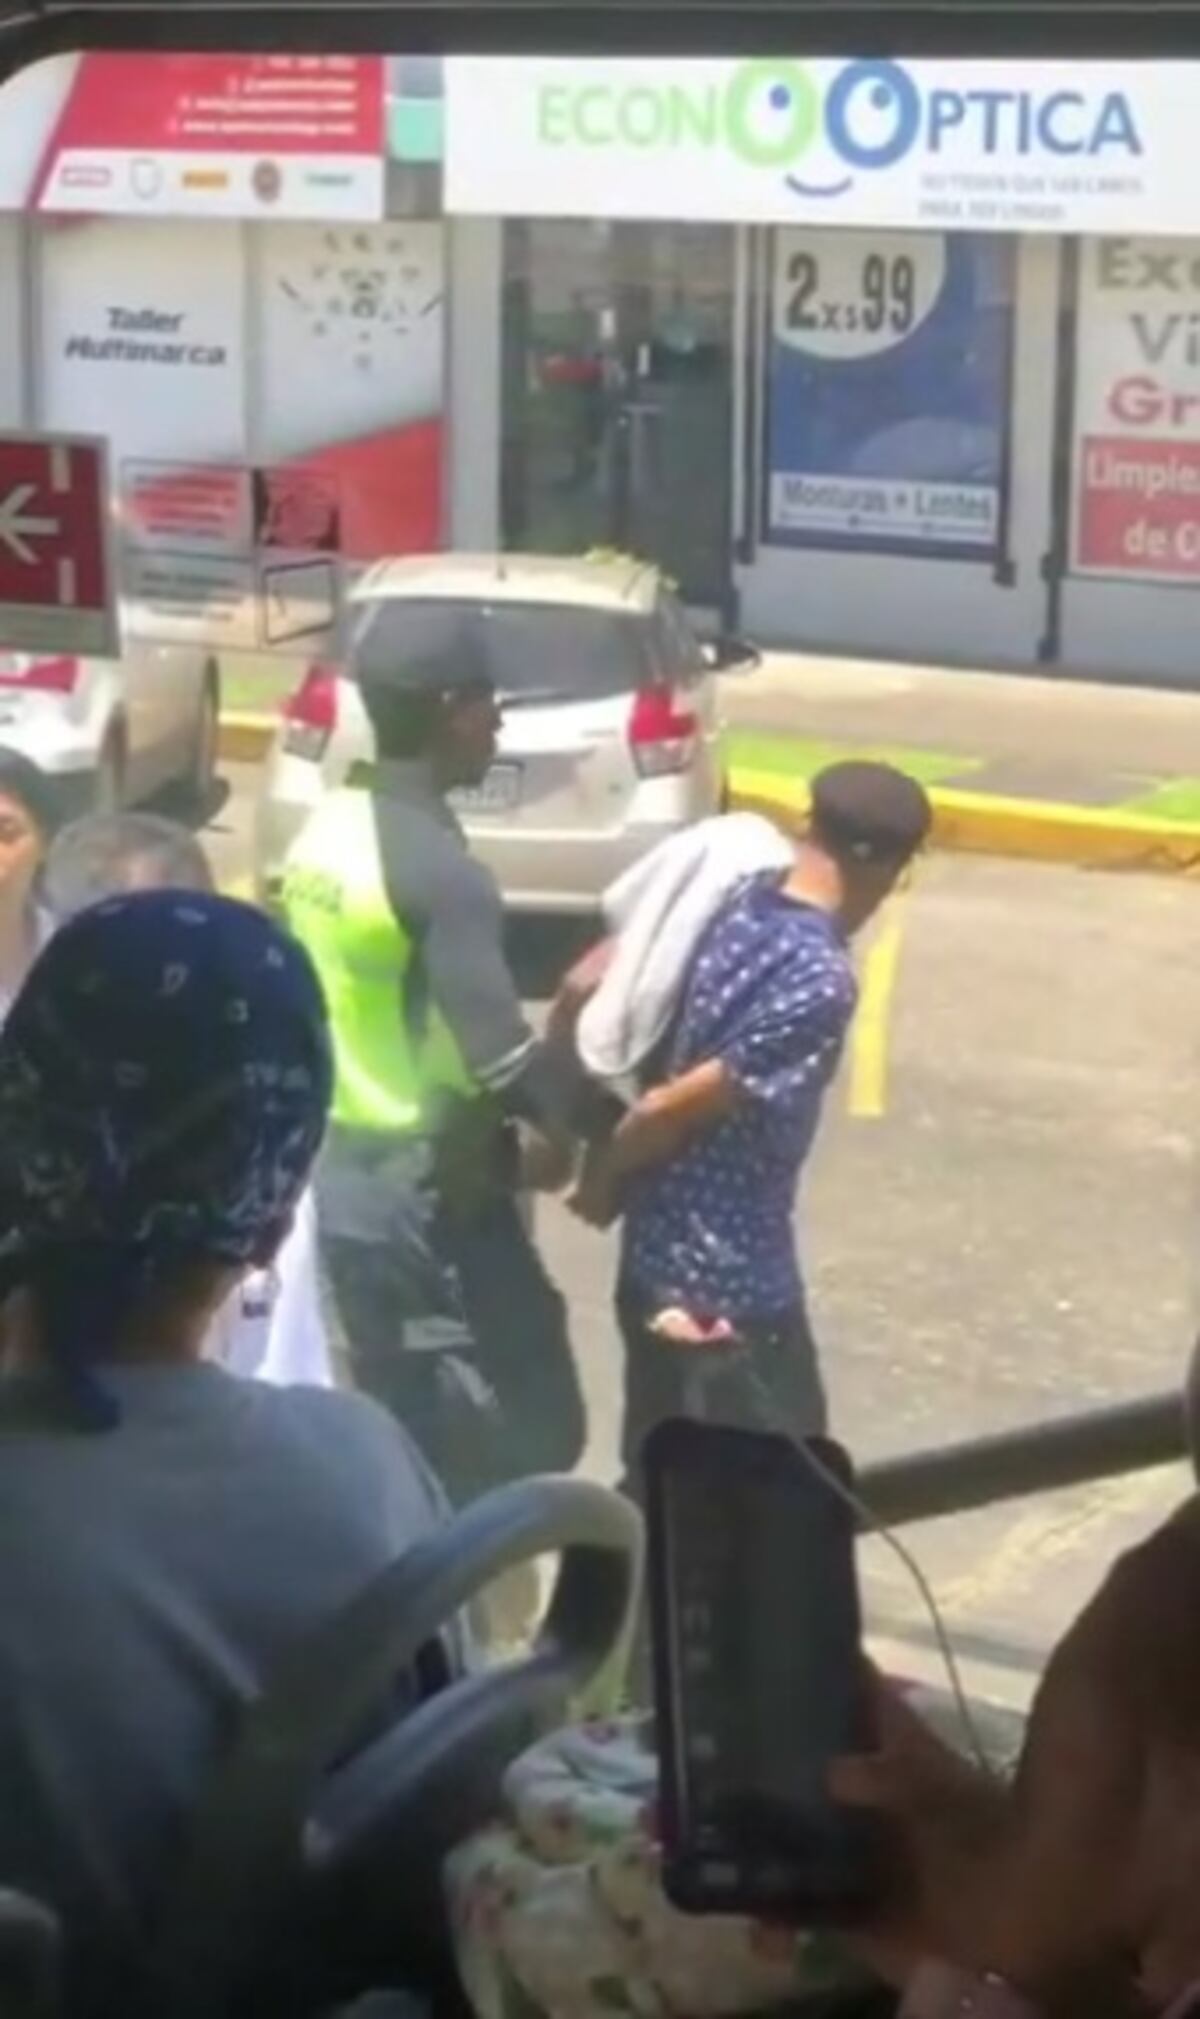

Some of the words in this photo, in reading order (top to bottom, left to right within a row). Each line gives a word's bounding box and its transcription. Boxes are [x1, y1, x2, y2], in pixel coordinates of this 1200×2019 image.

[106, 306, 185, 332] Taller
[65, 335, 226, 366] Multimarca
[1124, 519, 1166, 556] de
